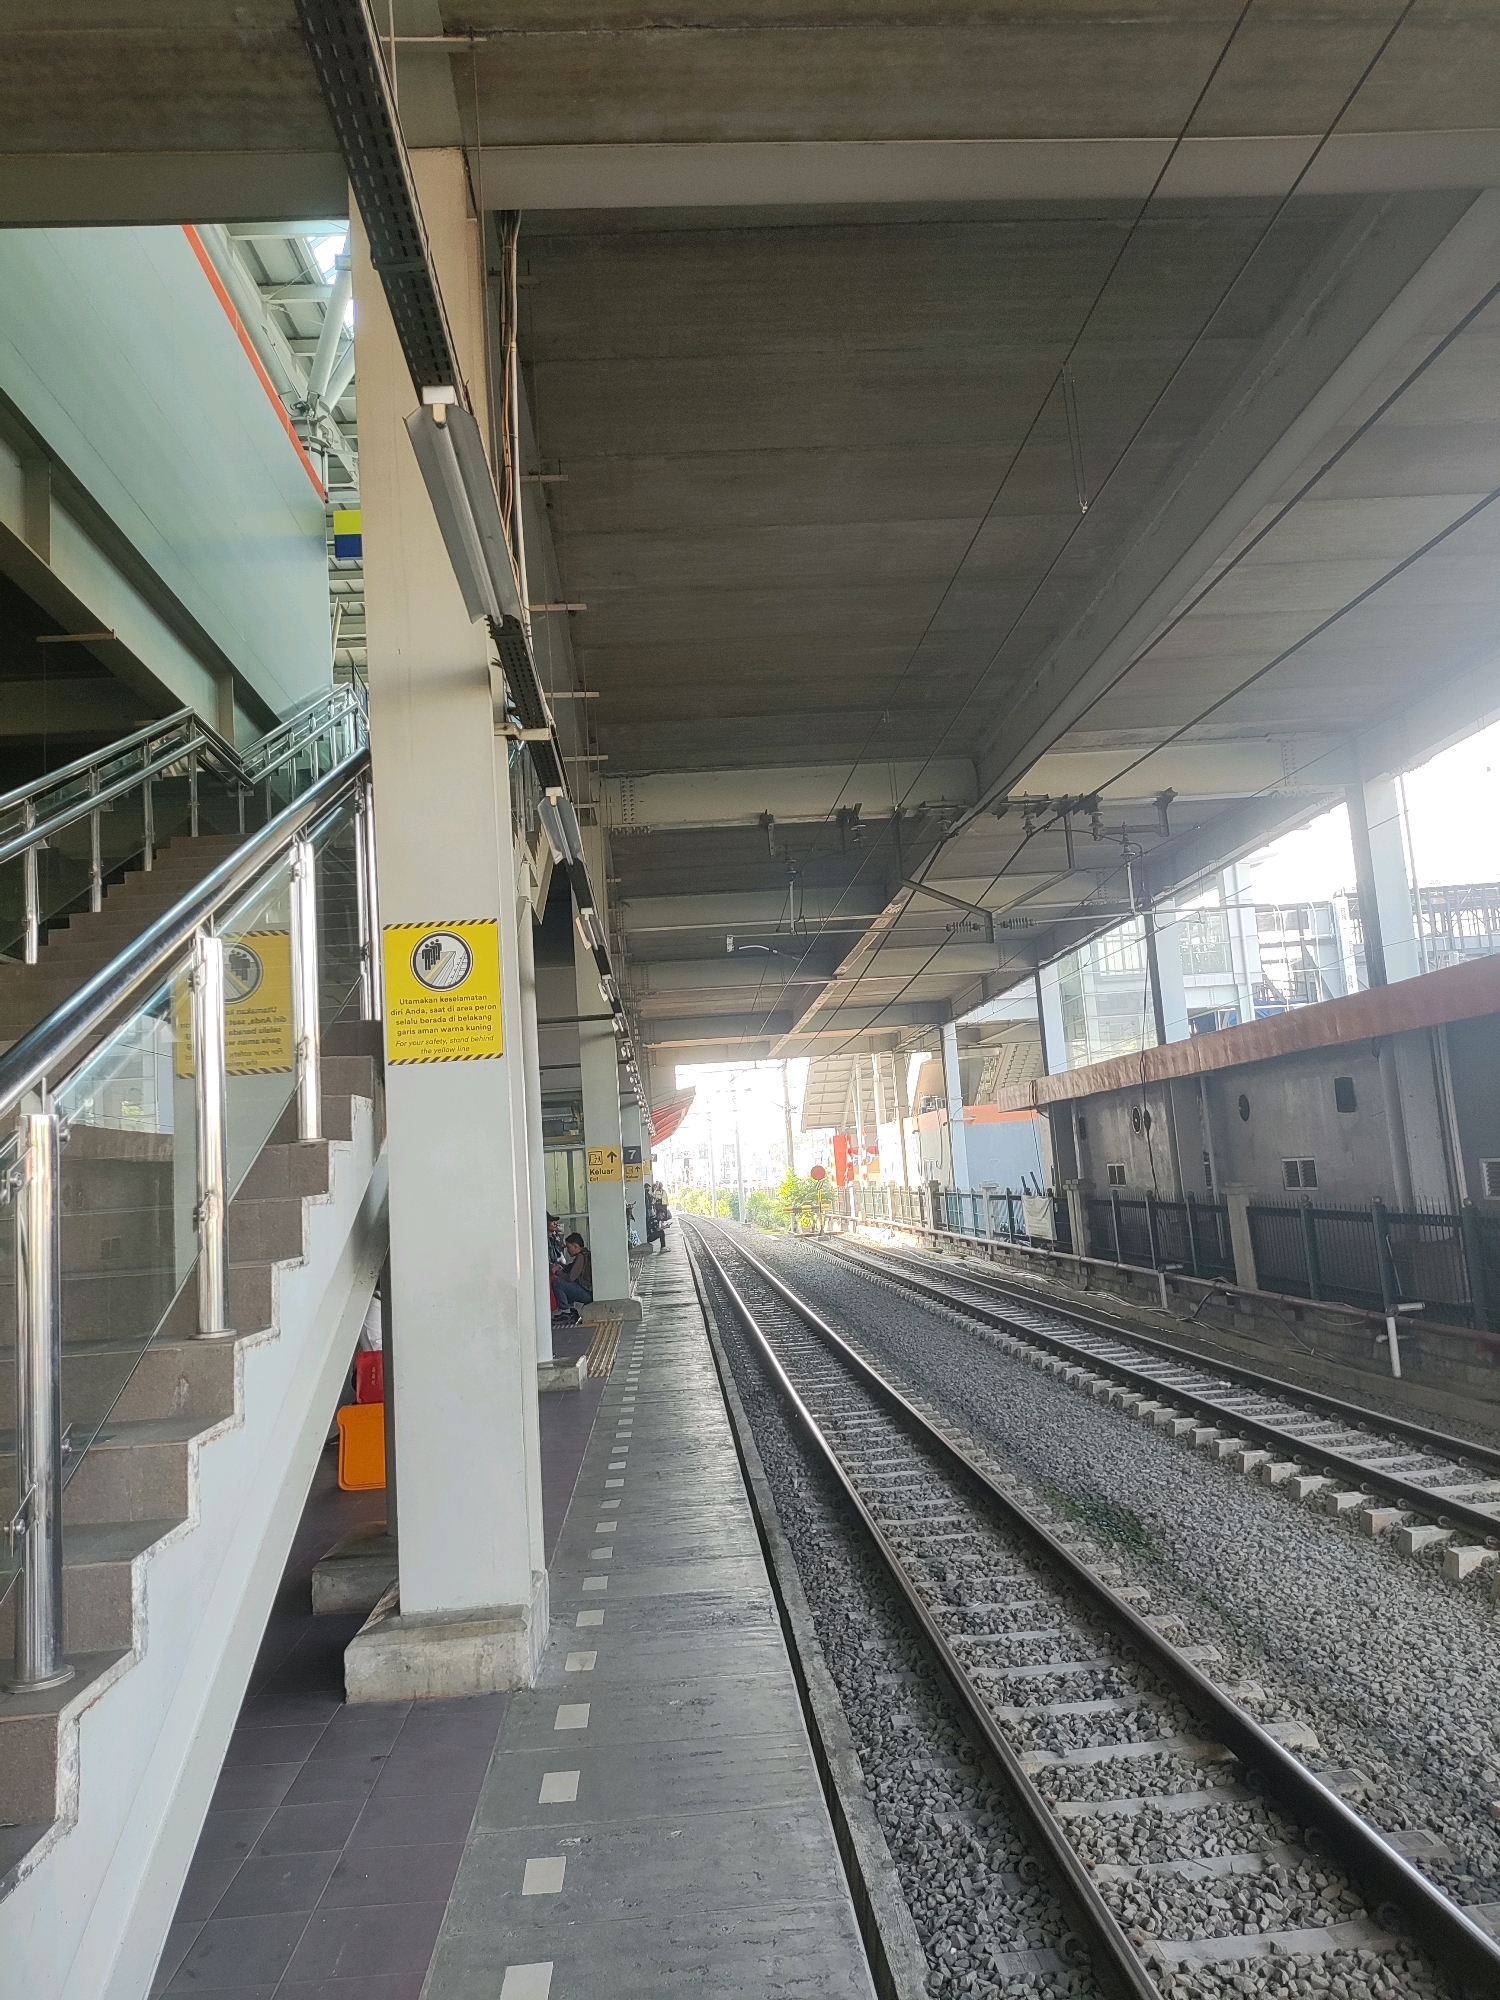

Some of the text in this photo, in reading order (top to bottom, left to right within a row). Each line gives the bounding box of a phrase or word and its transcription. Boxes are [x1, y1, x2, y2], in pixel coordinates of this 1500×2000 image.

[399, 995, 487, 1006] Utamakan keselamatan
[390, 1008, 403, 1016] diri
[405, 1007, 428, 1015] Anda,
[474, 1004, 497, 1012] peron
[395, 1018, 418, 1026] selalu
[420, 1016, 447, 1024] berada
[457, 1014, 492, 1022] belakang
[397, 1028, 416, 1037] garis
[466, 1024, 492, 1032] kuning
[408, 1040, 424, 1048] your
[449, 1036, 469, 1044] stand
[470, 1034, 494, 1042] behind
[433, 1047, 456, 1055] yellow
[628, 1149, 637, 1160] 7
